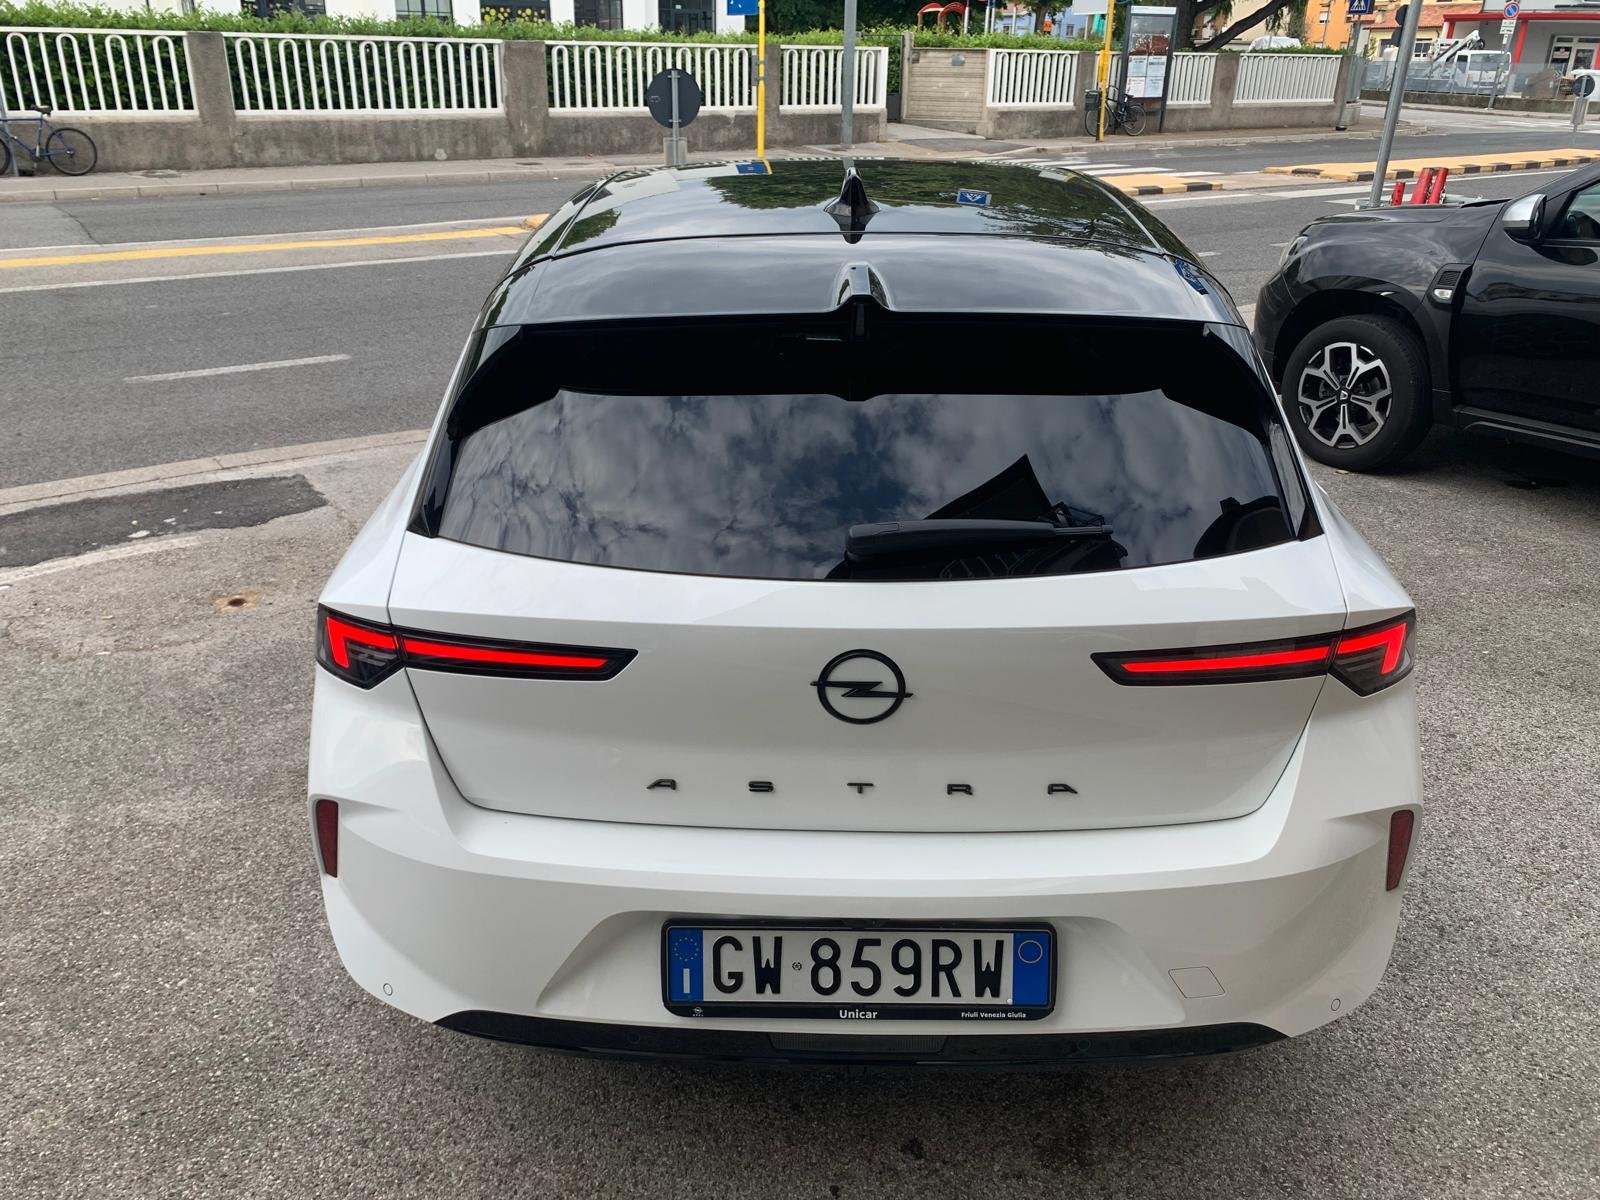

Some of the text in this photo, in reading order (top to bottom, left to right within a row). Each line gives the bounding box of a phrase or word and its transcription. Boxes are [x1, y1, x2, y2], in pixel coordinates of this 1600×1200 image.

[646, 778, 1079, 796] ASTRA
[712, 935, 1005, 998] GW 859RW
[839, 1009, 878, 1019] Unicar
